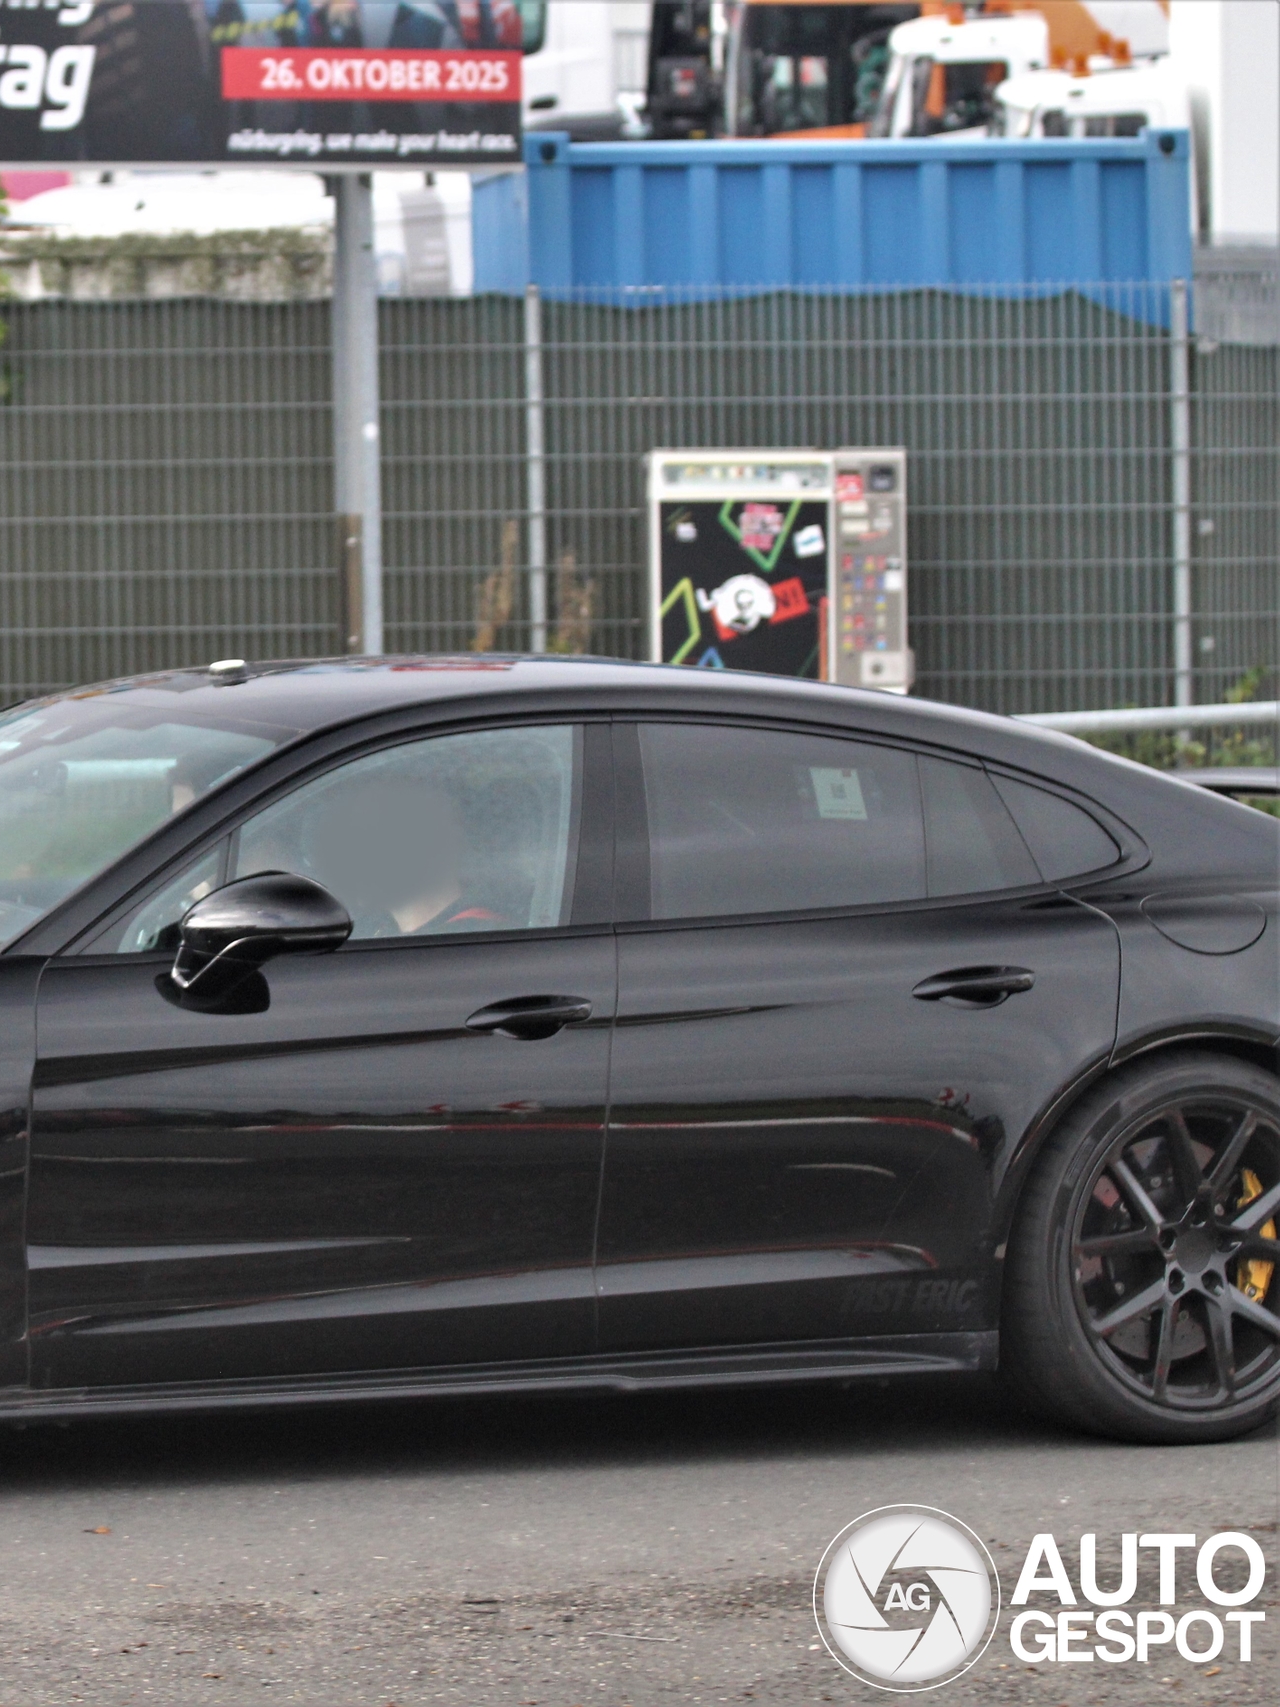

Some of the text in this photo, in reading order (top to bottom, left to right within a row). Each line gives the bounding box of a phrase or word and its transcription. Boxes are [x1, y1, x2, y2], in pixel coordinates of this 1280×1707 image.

[260, 58, 509, 92] 26. OKTOBER 2025
